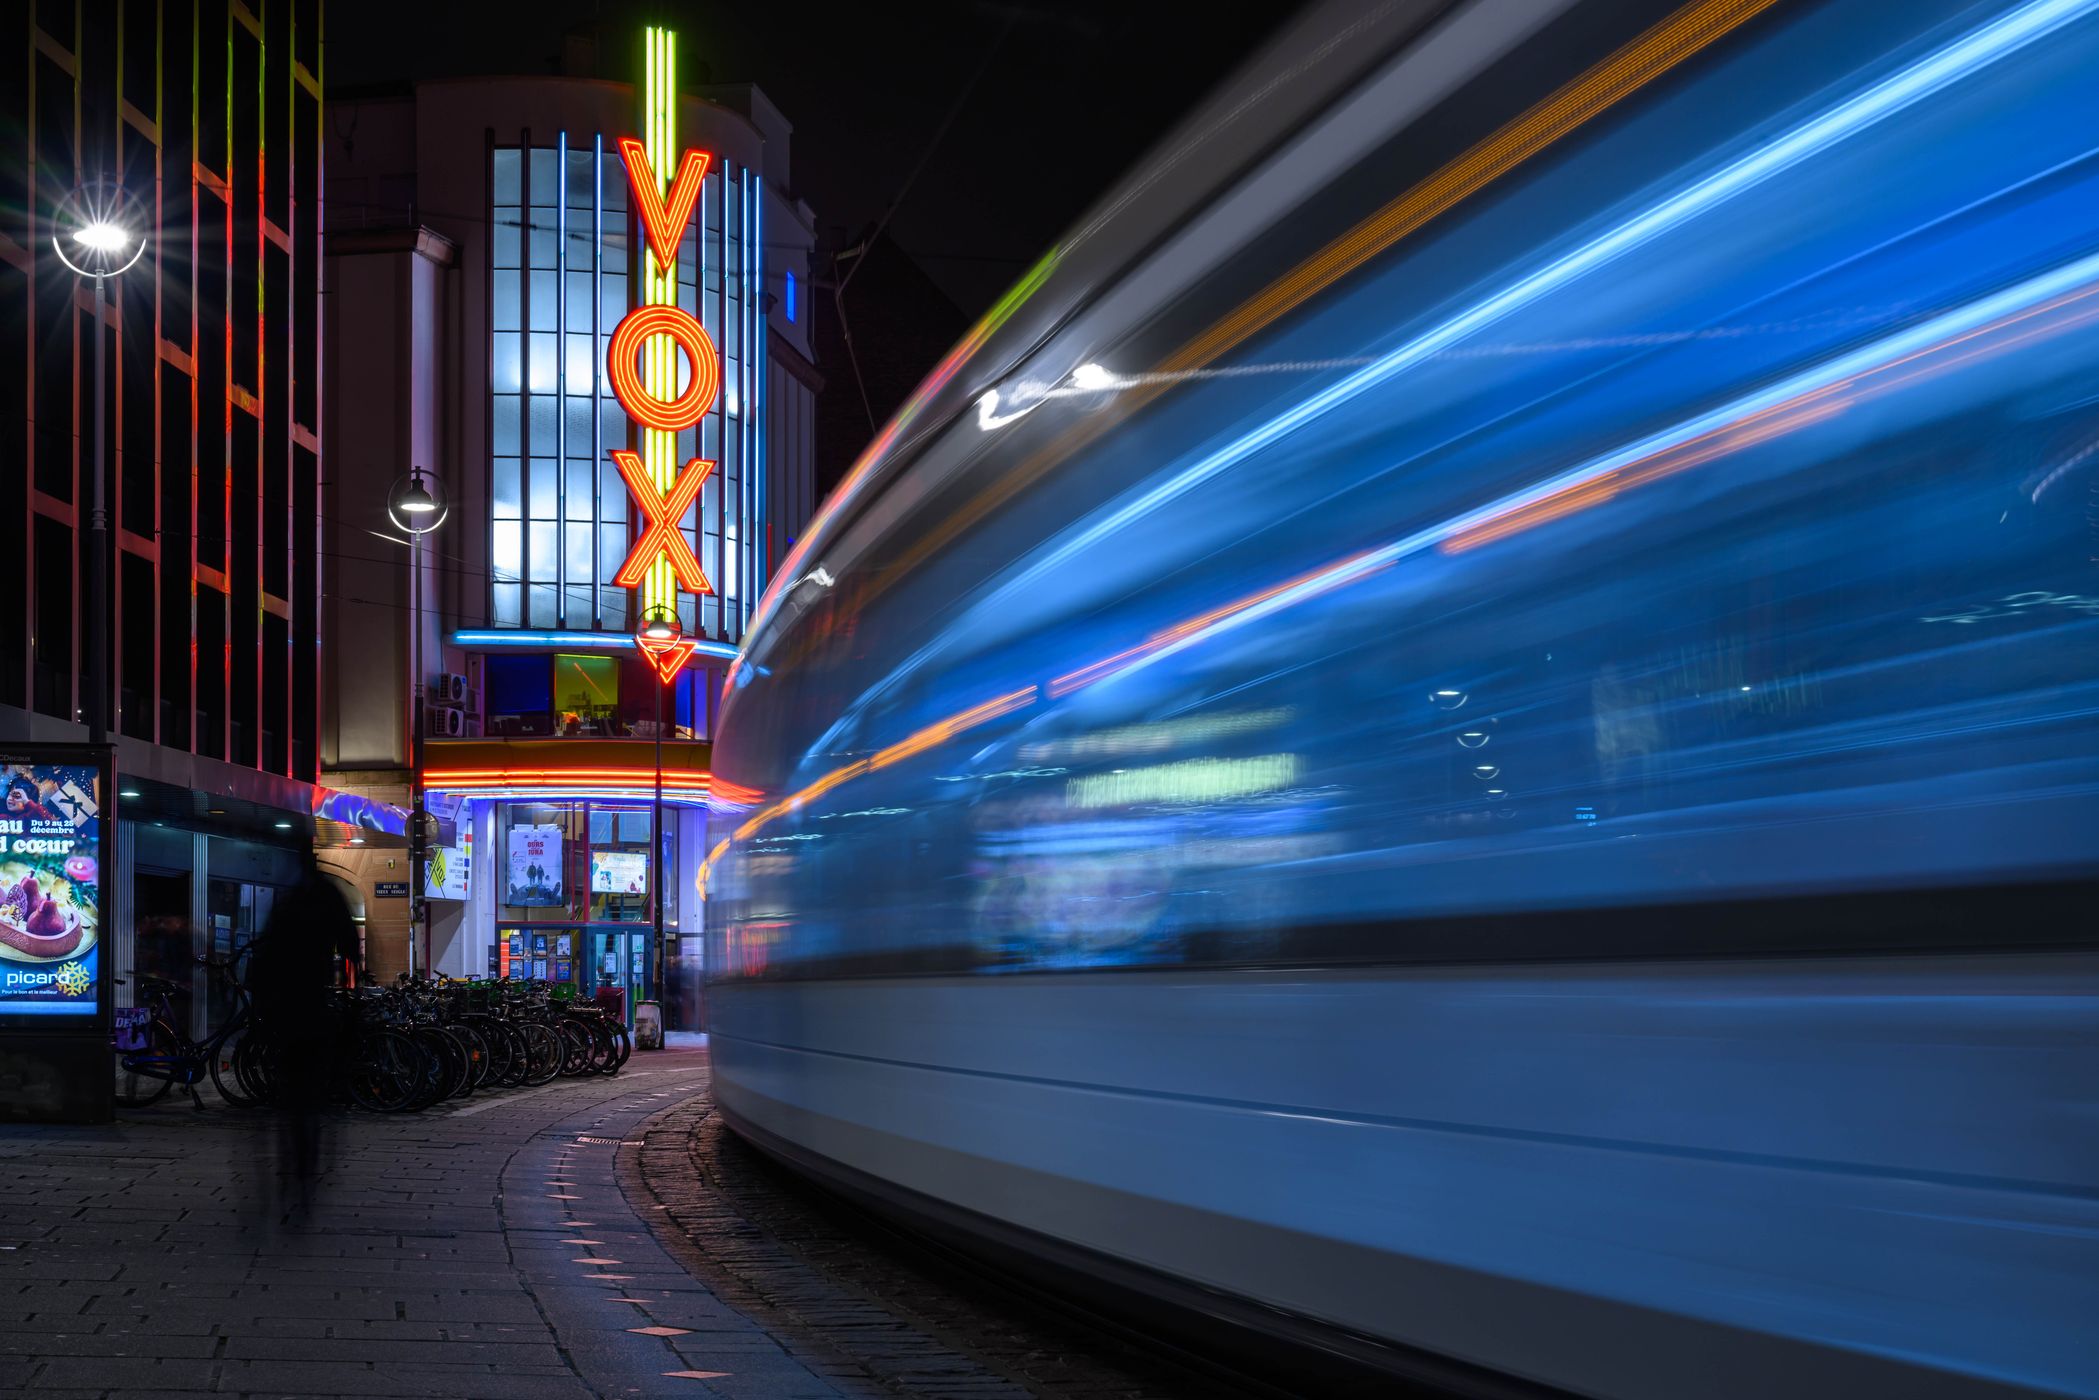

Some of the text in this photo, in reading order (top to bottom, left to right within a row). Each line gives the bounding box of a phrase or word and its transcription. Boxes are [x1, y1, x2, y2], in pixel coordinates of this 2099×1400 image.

[607, 138, 719, 593] VOX
[30, 826, 75, 834] décembre
[13, 839, 75, 853] cœur
[7, 971, 70, 986] picard
